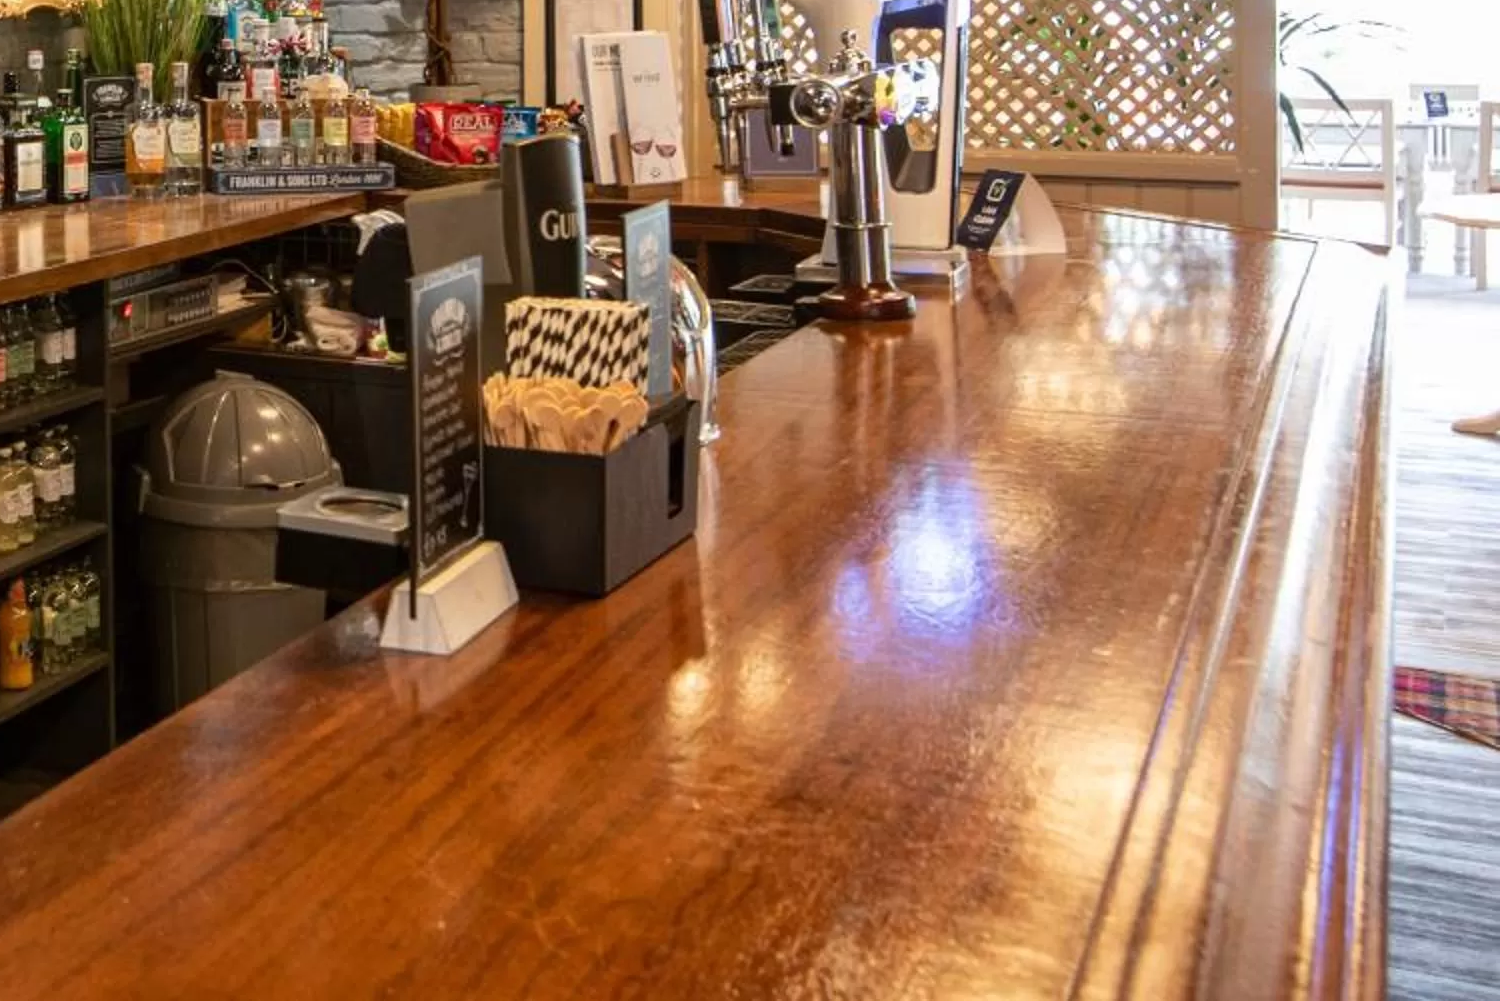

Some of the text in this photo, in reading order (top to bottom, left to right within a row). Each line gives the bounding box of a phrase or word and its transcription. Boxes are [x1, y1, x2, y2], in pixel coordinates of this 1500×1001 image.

[452, 114, 495, 130] REAL
[229, 175, 276, 188] FRANKLIN
[278, 176, 286, 188] &
